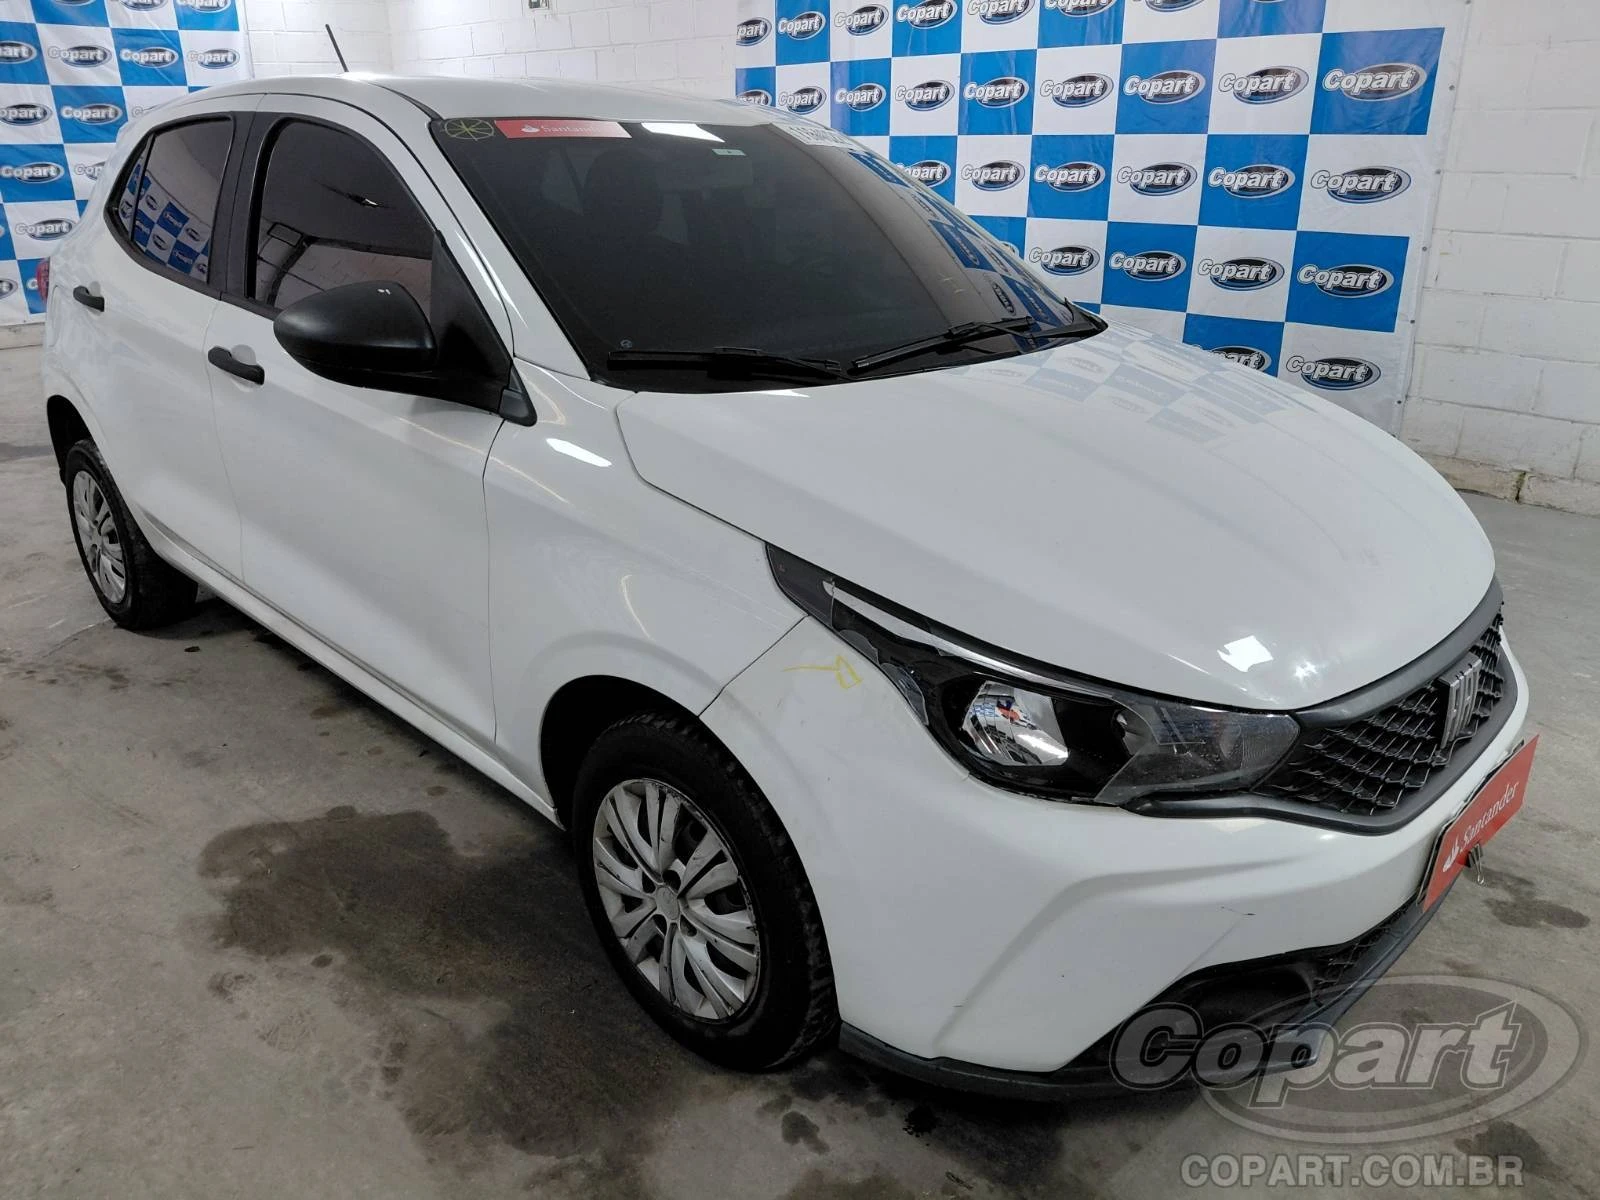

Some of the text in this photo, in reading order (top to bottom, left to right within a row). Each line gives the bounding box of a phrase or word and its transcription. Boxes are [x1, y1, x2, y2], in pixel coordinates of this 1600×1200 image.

[834, 9, 882, 32] Copart
[896, 1, 950, 25] Copart
[737, 21, 765, 40] part
[778, 15, 820, 36] Copart
[48, 46, 104, 62] Copart
[119, 48, 172, 64] Copart
[187, 50, 235, 65] Copart
[963, 80, 1022, 102] Copart
[1040, 76, 1105, 99] Copart
[1124, 74, 1196, 101] Copart
[1218, 70, 1297, 98] Copart
[1323, 66, 1415, 97] Copart
[778, 89, 818, 109] Copart
[835, 86, 878, 107] Copart
[895, 84, 948, 105] Copart
[0, 107, 43, 121] opart
[60, 105, 116, 120] Copart
[1, 165, 58, 179] Copart
[75, 163, 102, 179] Cop
[960, 164, 1016, 186] Copart
[1034, 164, 1097, 187] Copart
[1116, 166, 1188, 191] Copart
[1208, 165, 1285, 194] Copart
[1311, 169, 1402, 195] Copart
[15, 221, 68, 238] Copart
[1029, 247, 1089, 269] Copart
[1109, 252, 1176, 274] Copart
[1198, 259, 1271, 283] Copart
[1298, 264, 1383, 292] Copart
[1286, 356, 1369, 384] Copart
[1458, 780, 1521, 852] Santander
